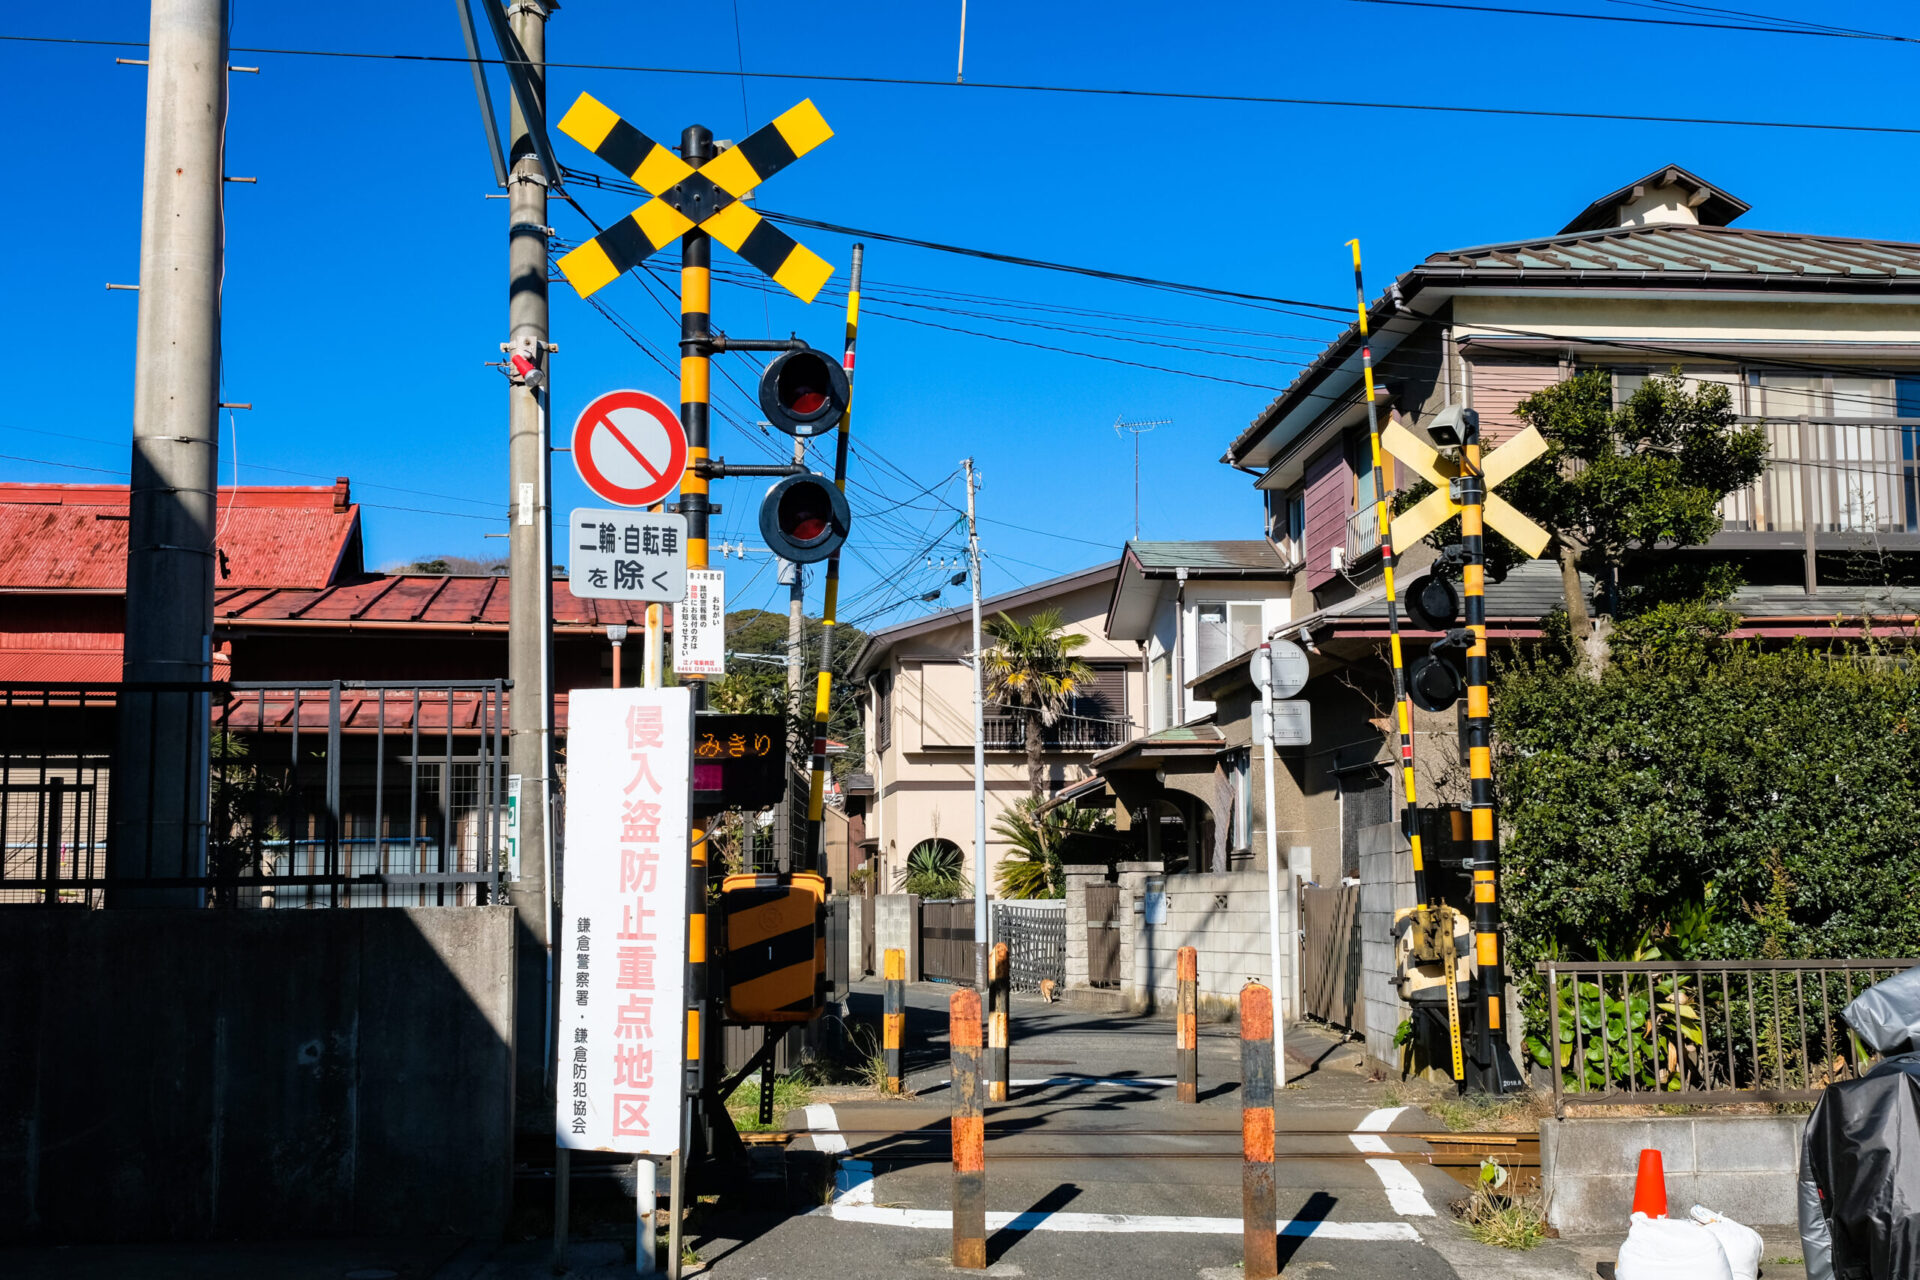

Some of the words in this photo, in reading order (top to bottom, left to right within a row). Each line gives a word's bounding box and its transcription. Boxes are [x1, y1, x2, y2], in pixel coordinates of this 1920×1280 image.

[580, 522, 678, 557] 二輪・自転車
[587, 559, 669, 592] を除く
[681, 585, 689, 657] にお知らせ下さい
[690, 584, 698, 650] 故障にお気付の方は
[699, 584, 707, 628] 踏切警報機の
[712, 596, 720, 626] おねがい
[694, 733, 771, 757] みきり
[612, 704, 665, 1137] 侵入盗防止重点地区
